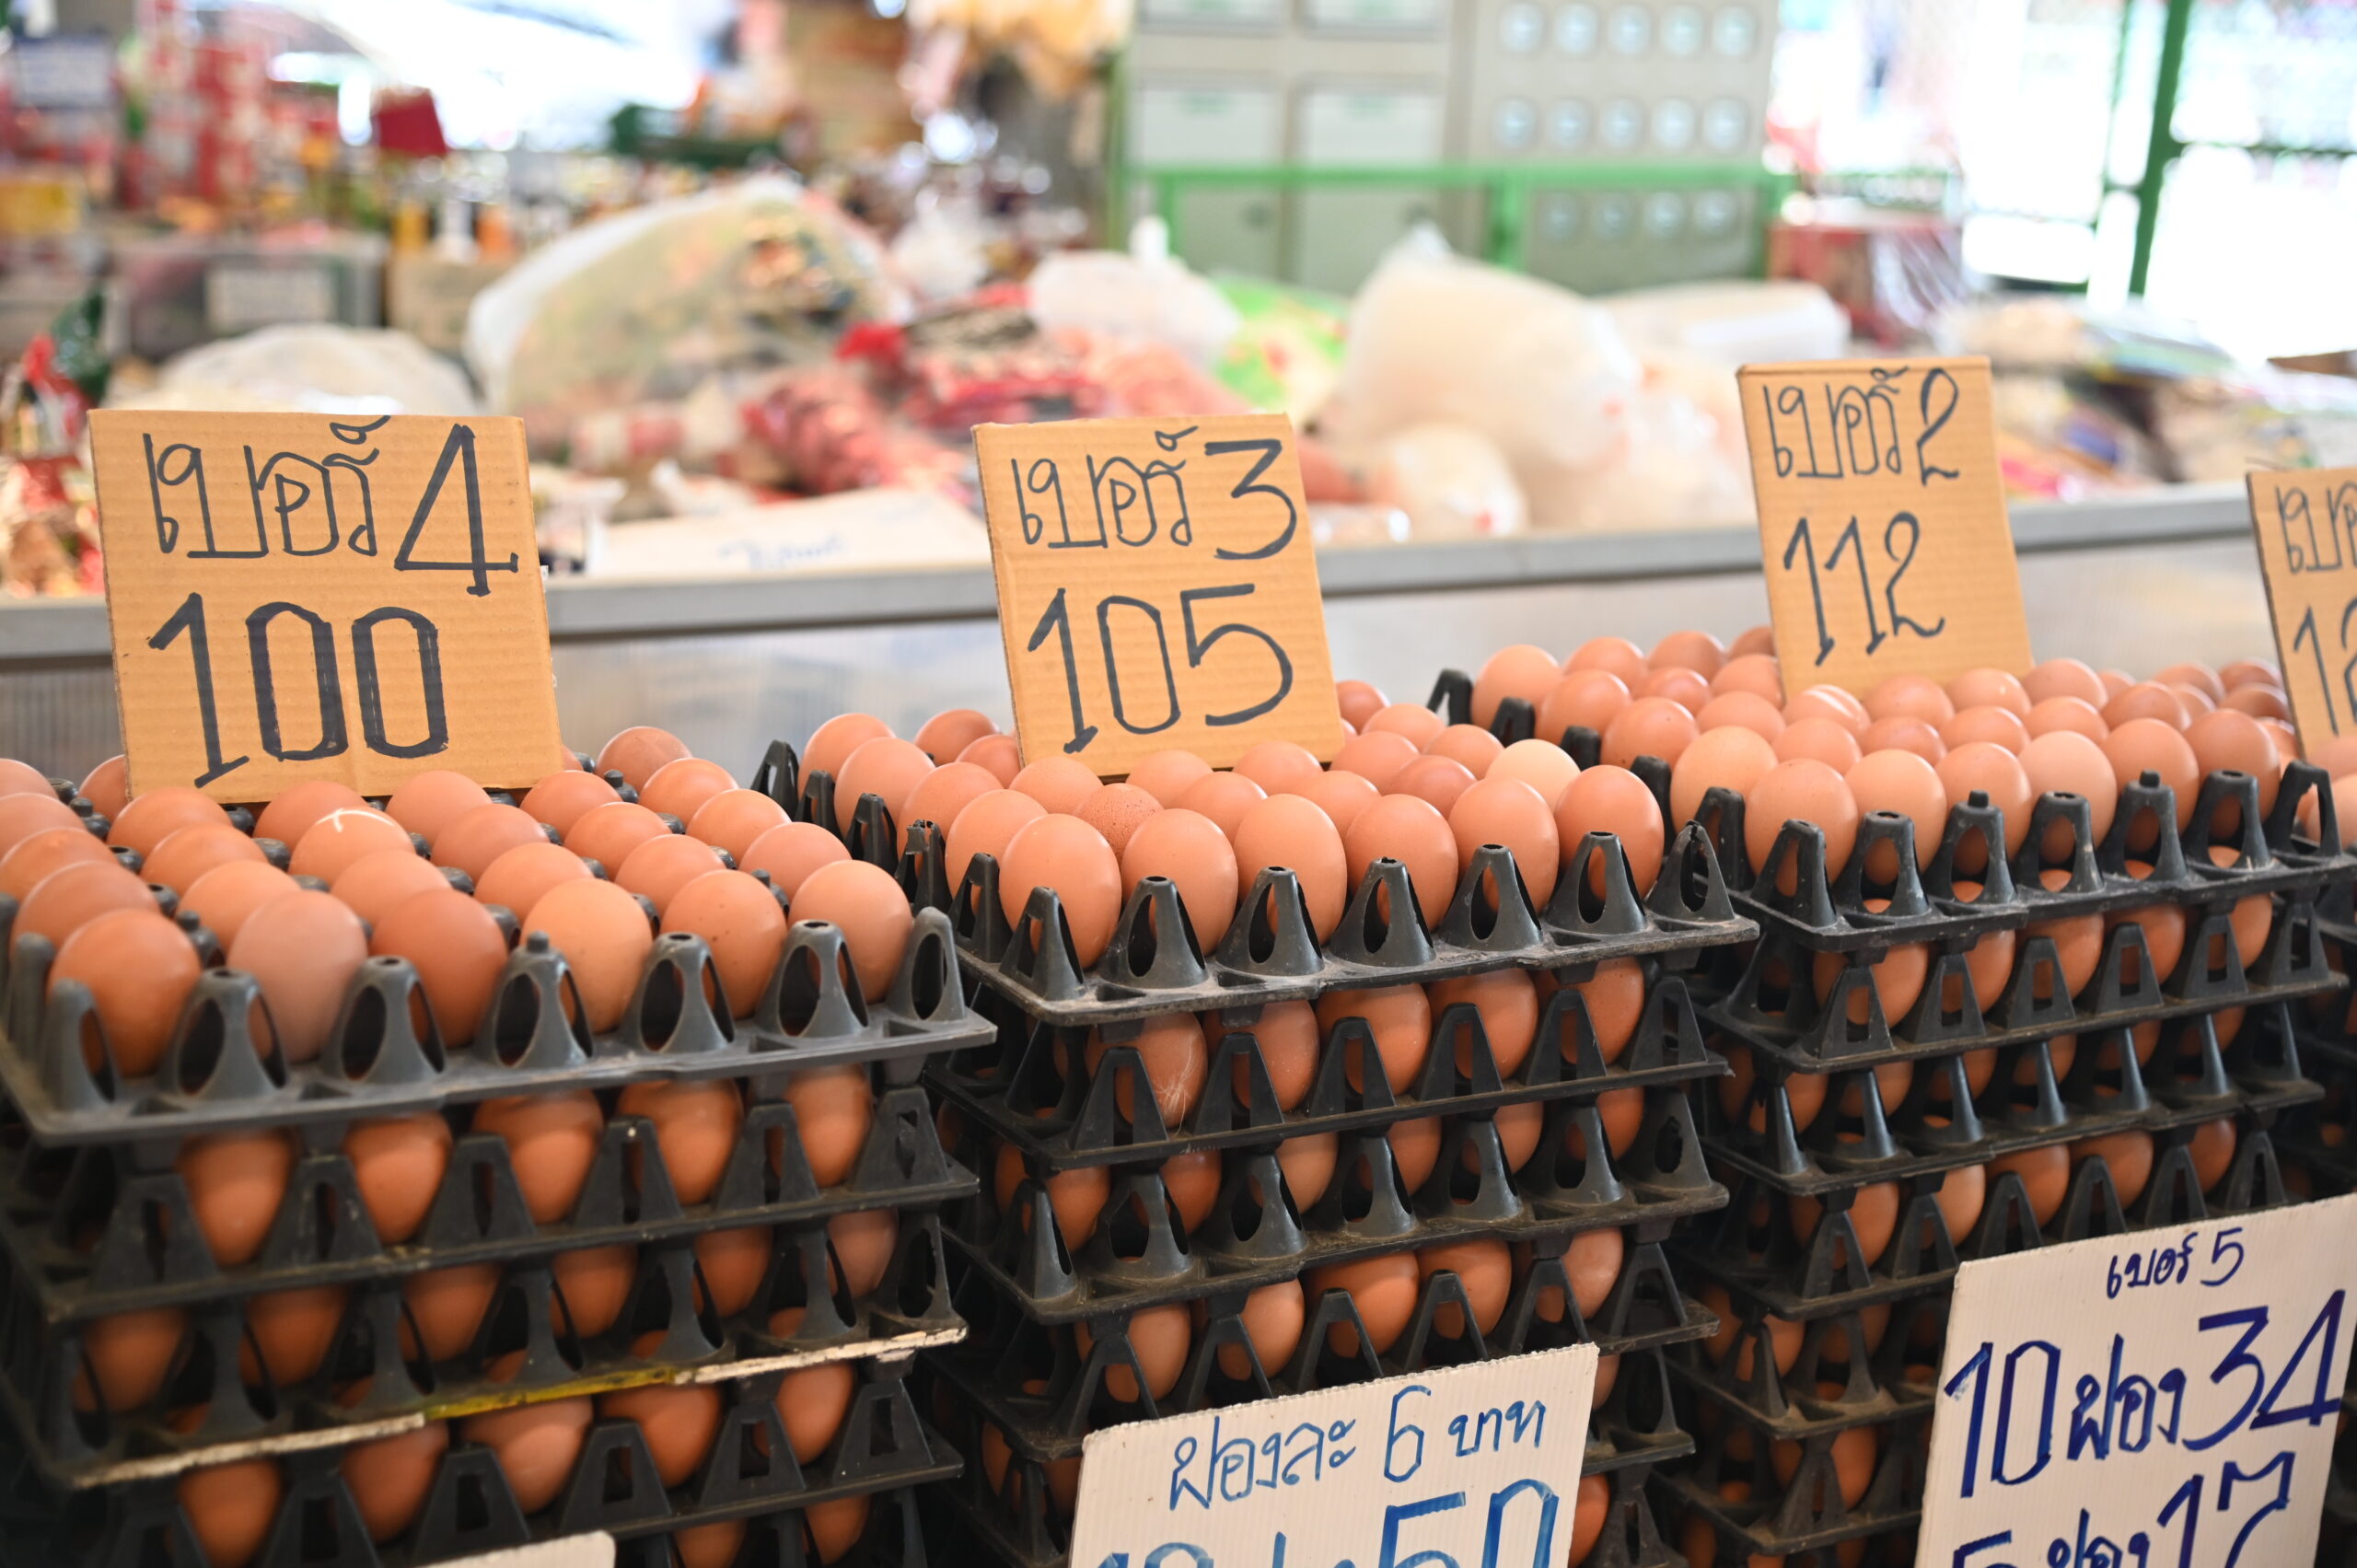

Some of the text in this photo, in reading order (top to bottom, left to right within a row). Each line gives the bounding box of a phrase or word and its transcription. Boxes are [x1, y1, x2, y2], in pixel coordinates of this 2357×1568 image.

[1011, 425, 1297, 560] เบอร์ 3
[1763, 366, 1959, 486] เบอร์ 2
[143, 415, 518, 597] เบอร์ 4
[1783, 512, 1945, 667] 112
[148, 592, 448, 787] 100
[1028, 583, 1293, 753] 105
[2107, 1227, 2244, 1299] เบอร์ 5
[1384, 1385, 1432, 1482] 6
[1448, 1400, 1546, 1457] บาท
[1945, 1341, 2061, 1497] 10
[2183, 1290, 2346, 1450] 34
[2157, 1451, 2295, 1568] 17
